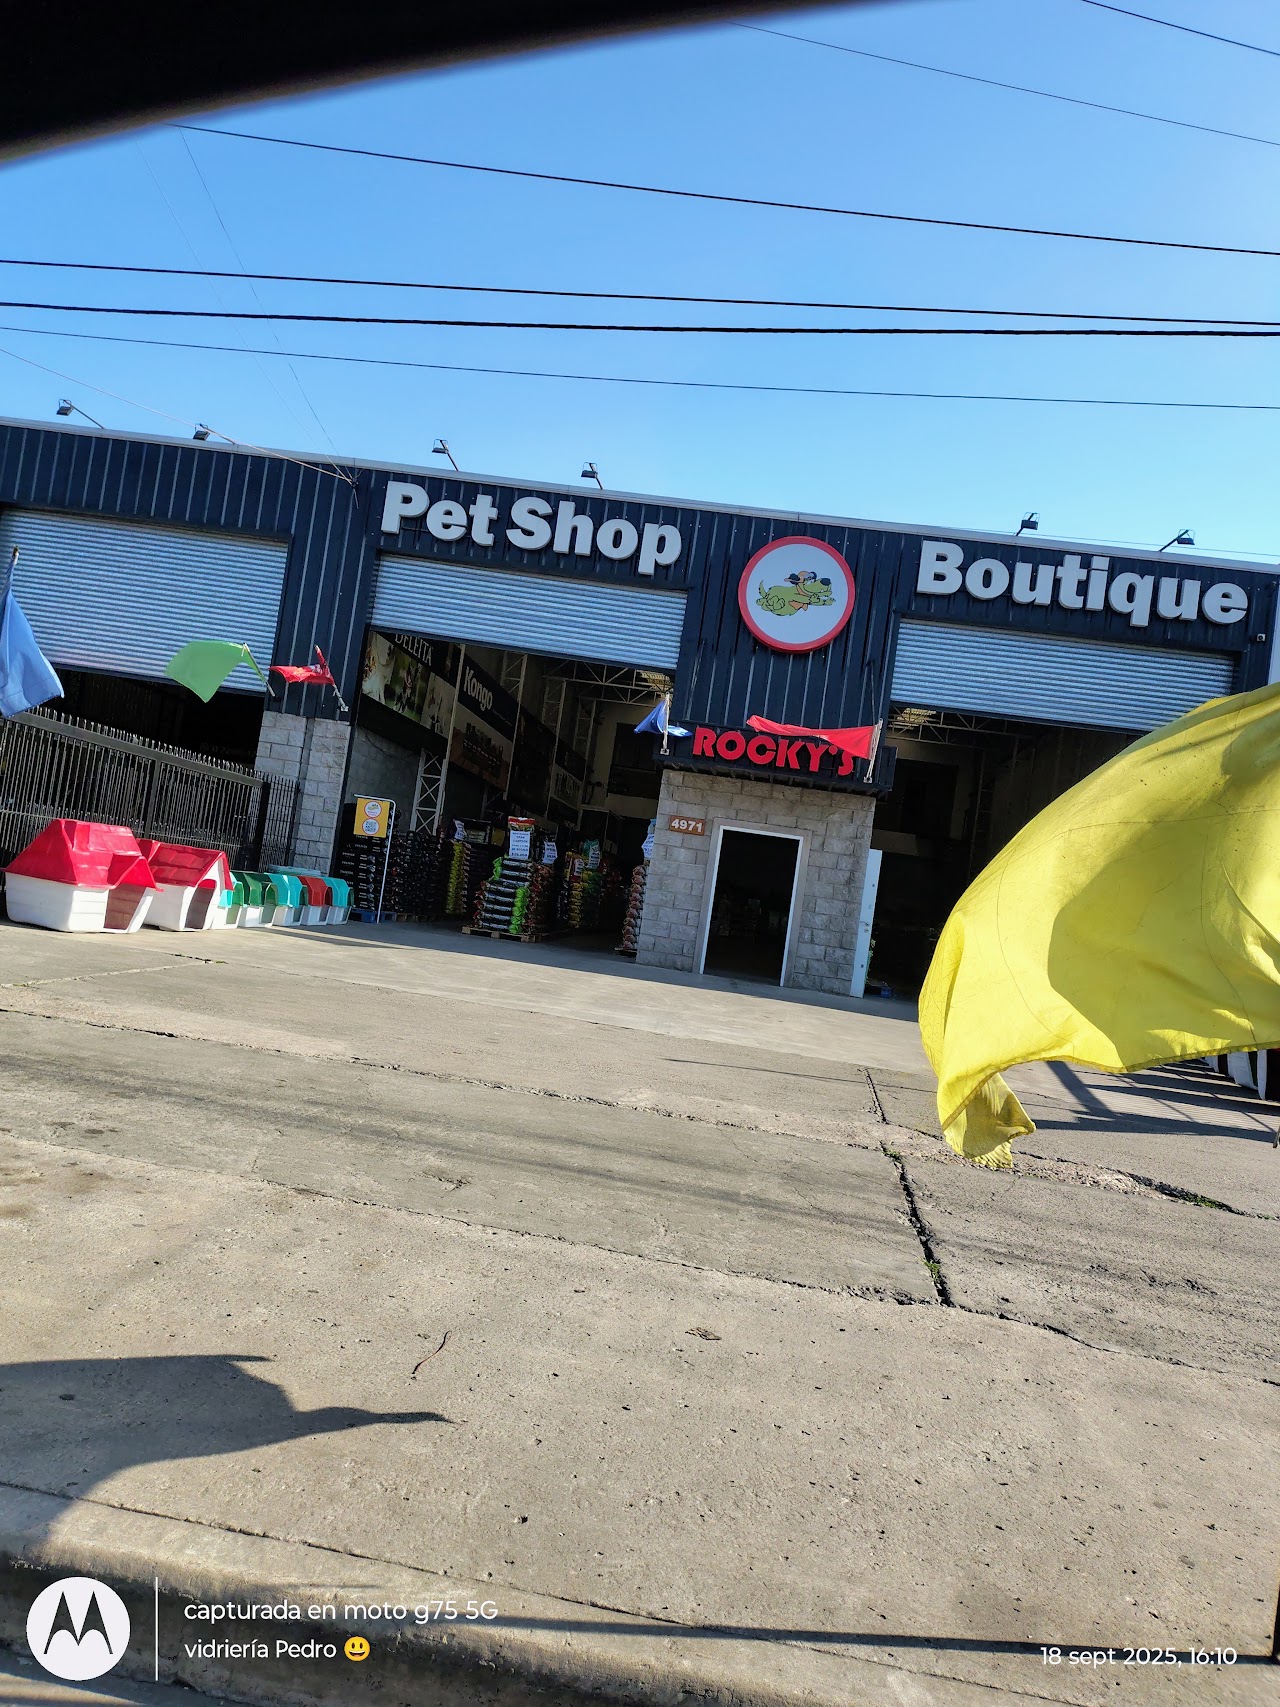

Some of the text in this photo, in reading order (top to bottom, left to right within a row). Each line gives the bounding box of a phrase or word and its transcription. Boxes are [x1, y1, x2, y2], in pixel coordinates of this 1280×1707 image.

[381, 480, 682, 576] Pet Shop
[916, 540, 1249, 627] Boutique
[463, 665, 493, 711] Kongo
[670, 818, 704, 833] 4971
